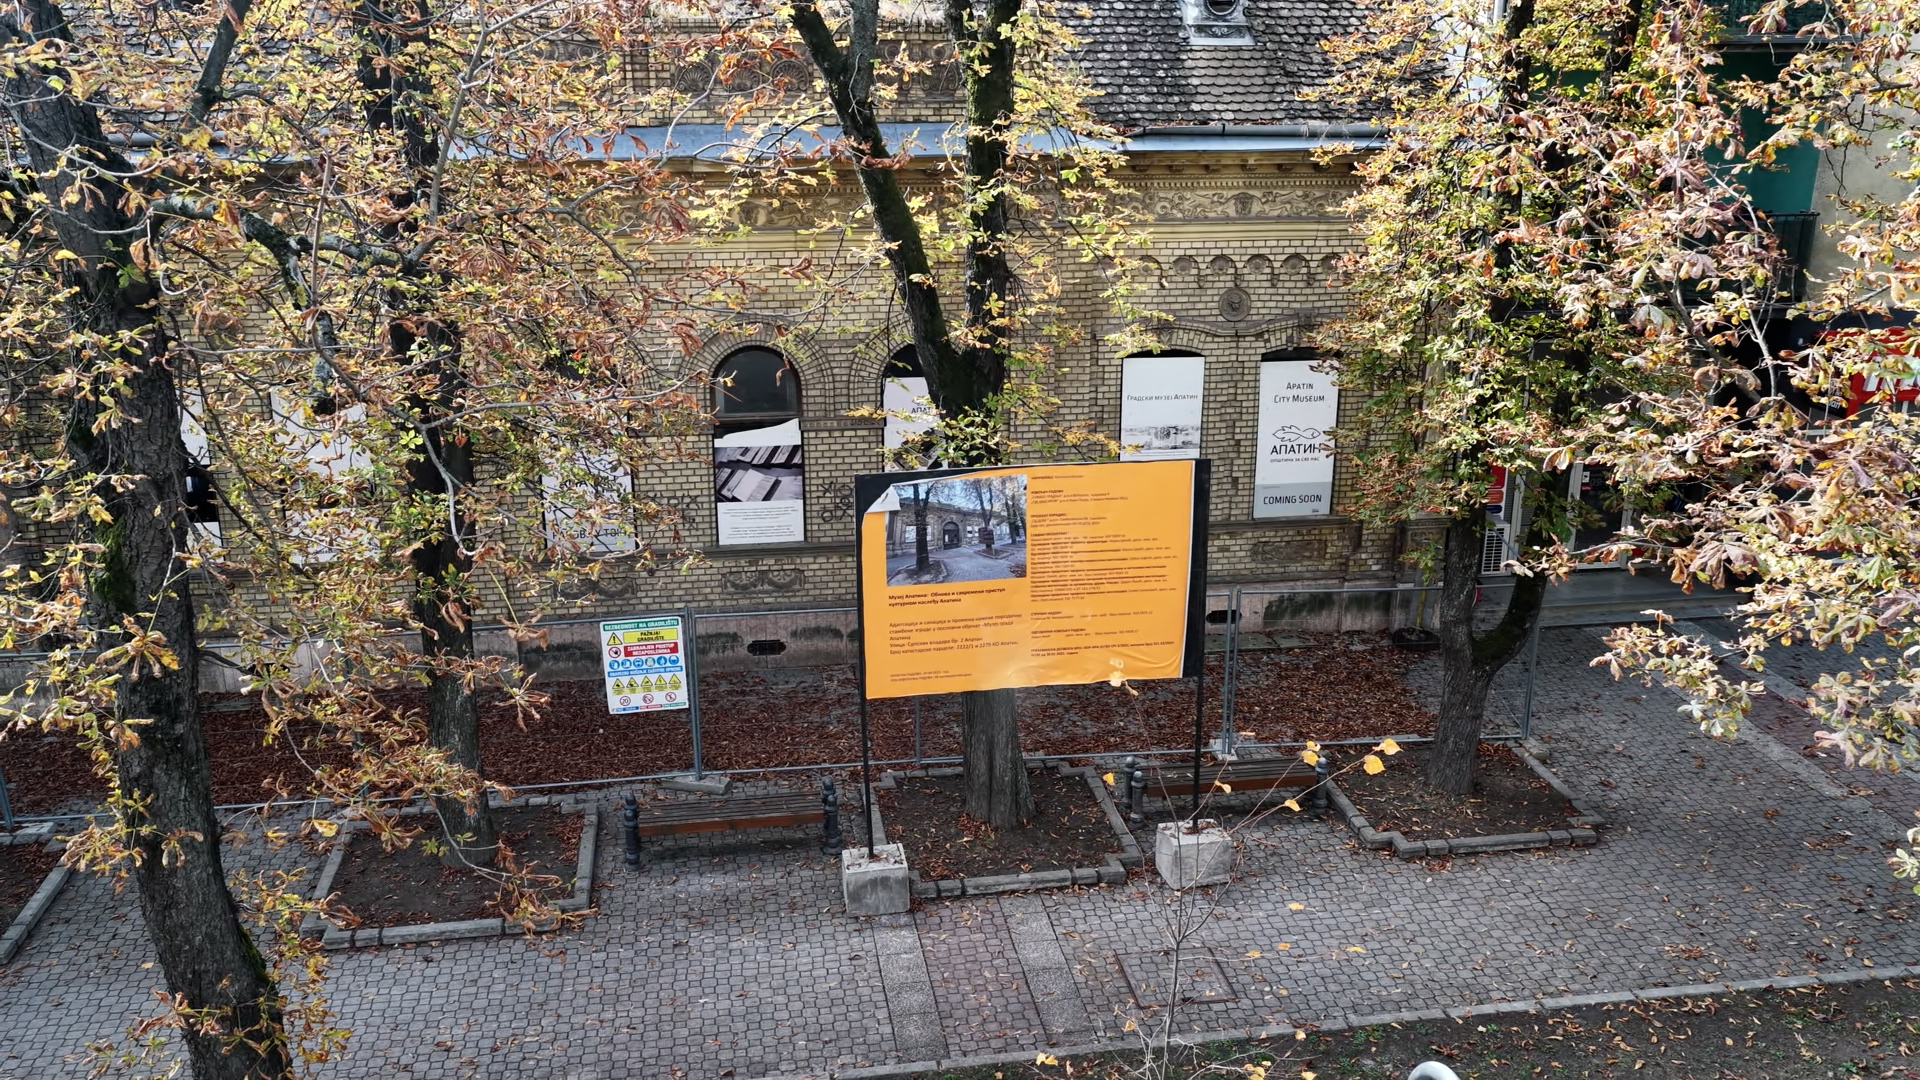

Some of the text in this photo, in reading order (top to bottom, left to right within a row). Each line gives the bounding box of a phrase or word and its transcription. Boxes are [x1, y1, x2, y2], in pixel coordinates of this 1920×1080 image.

[1270, 444, 1321, 455] АПАТИН
[1264, 495, 1322, 505] COMING SOON
